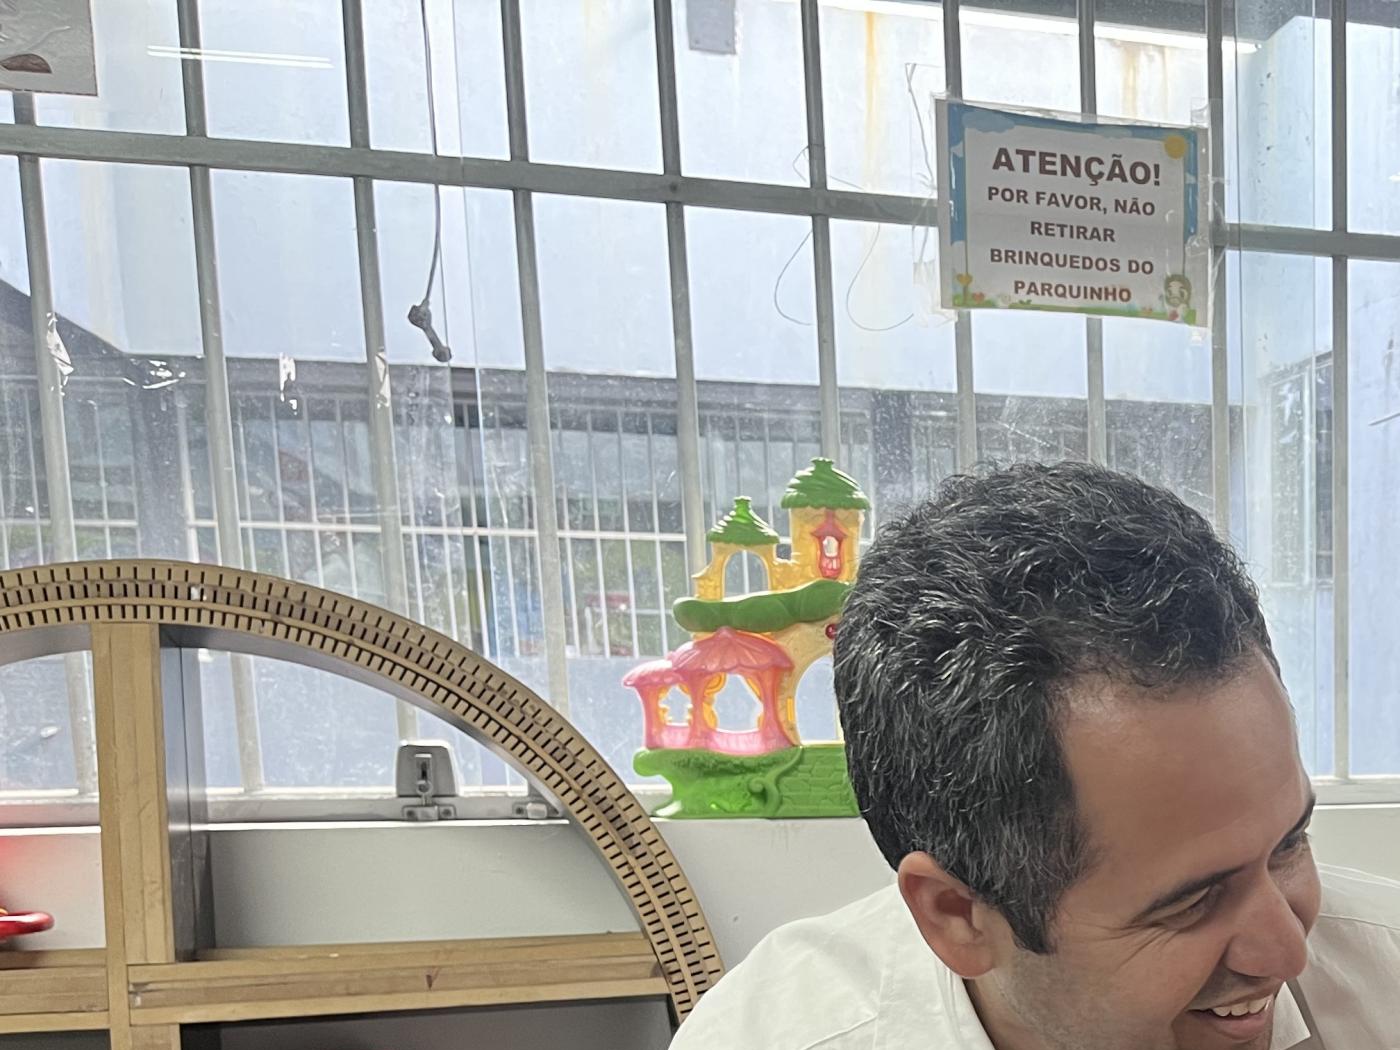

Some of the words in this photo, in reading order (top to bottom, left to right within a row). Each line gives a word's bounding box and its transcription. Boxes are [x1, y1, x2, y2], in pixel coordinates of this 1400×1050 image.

[991, 147, 1161, 187] ATENÇÃO!
[987, 186, 1029, 205] POR
[1035, 191, 1108, 215] FAVOR,
[1113, 195, 1156, 217] NÃO
[1030, 221, 1116, 243] RETIRAR
[989, 248, 1121, 273] BRINQUEDOS
[1127, 259, 1155, 275] DO
[1013, 280, 1132, 303] PARQUINHO
